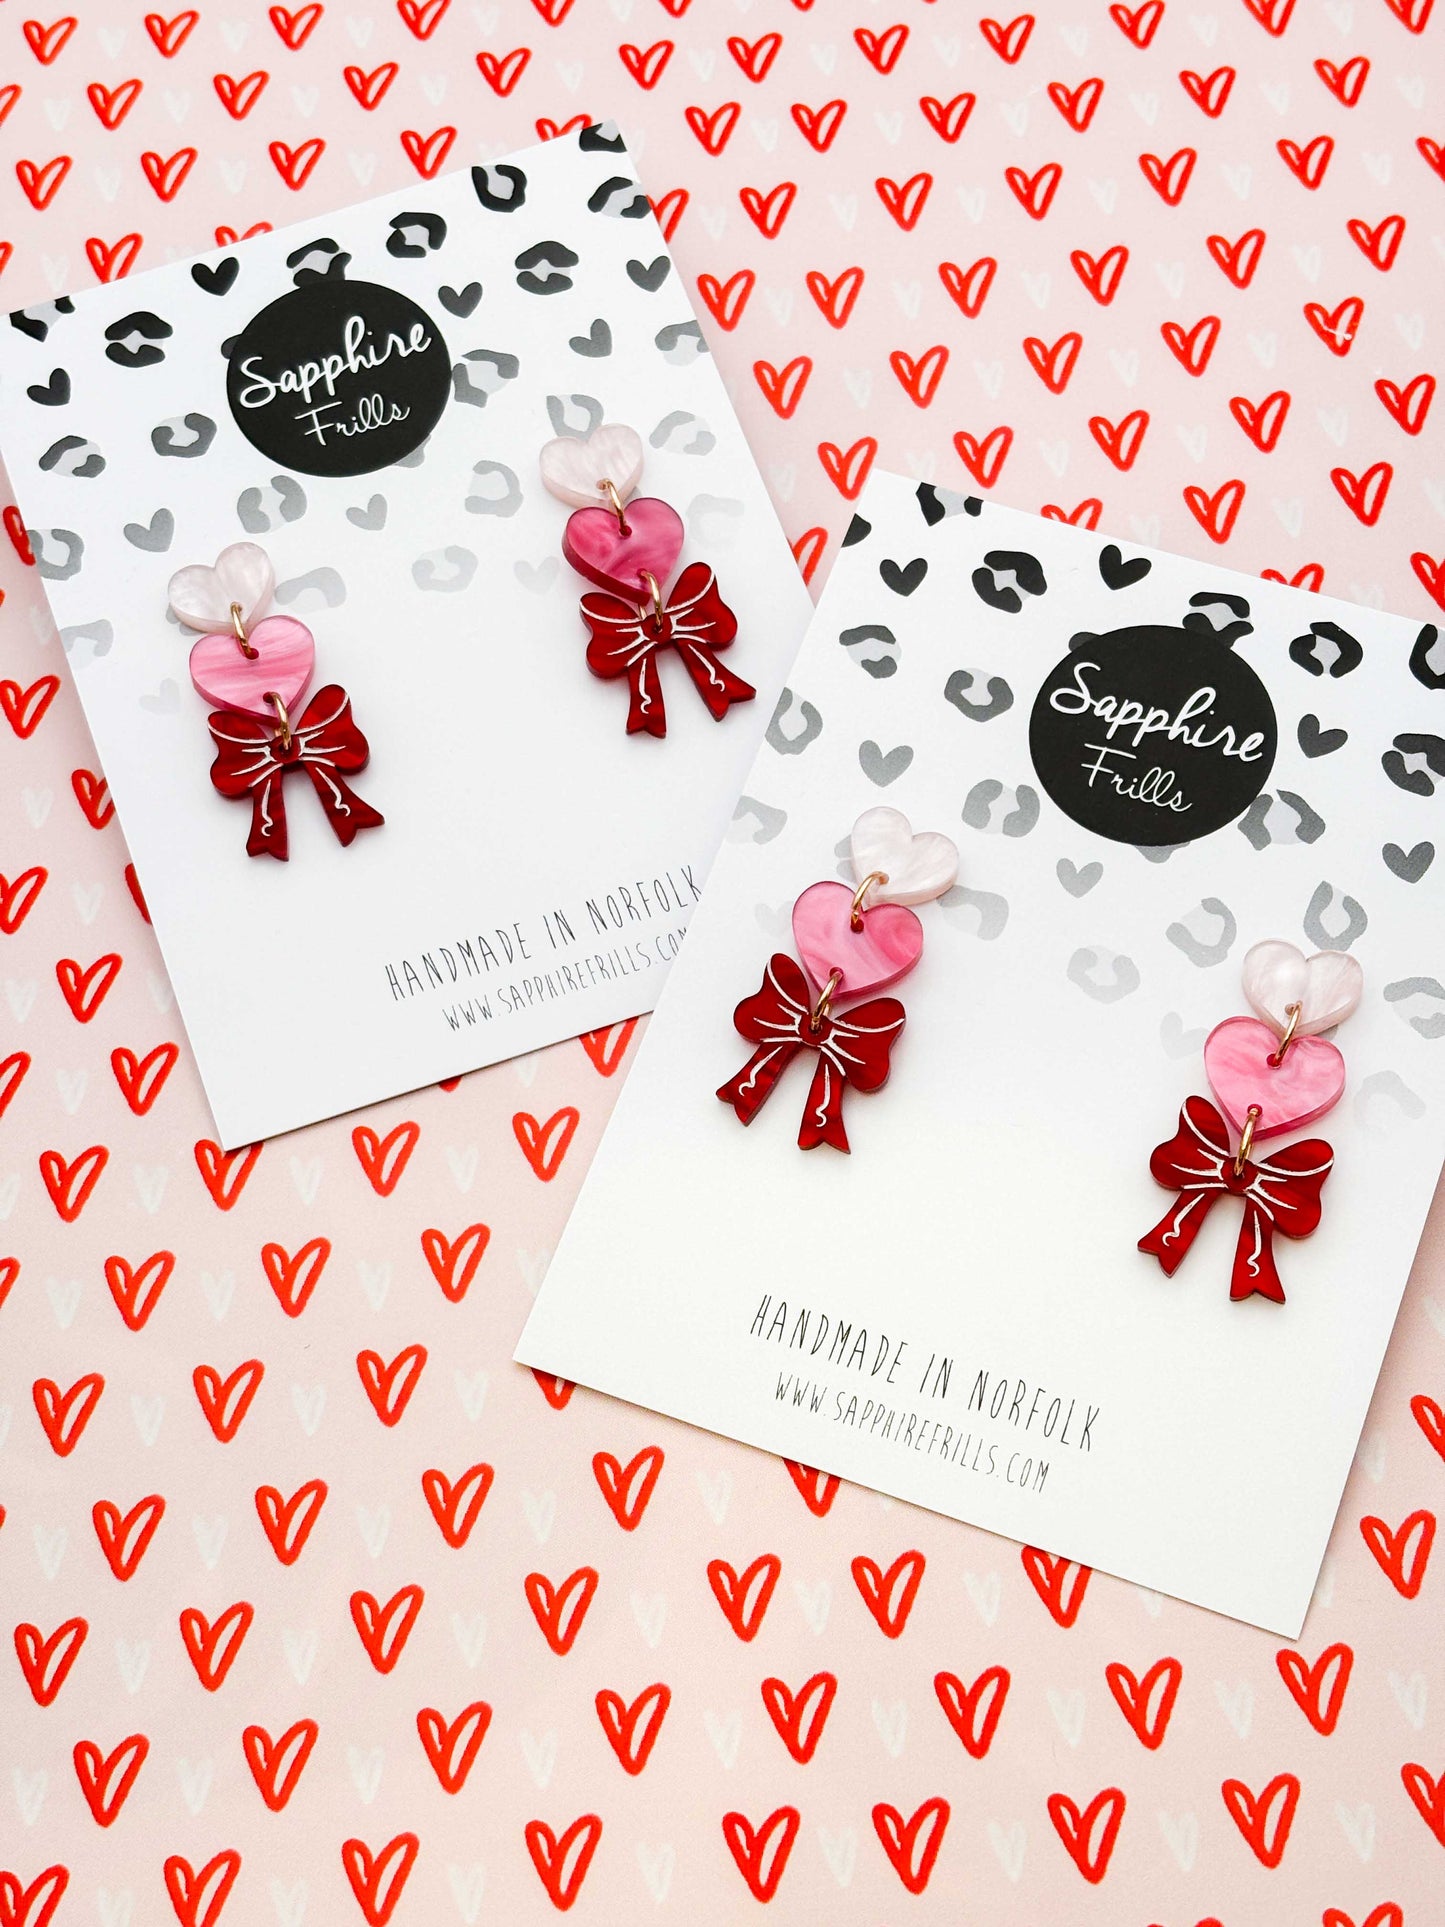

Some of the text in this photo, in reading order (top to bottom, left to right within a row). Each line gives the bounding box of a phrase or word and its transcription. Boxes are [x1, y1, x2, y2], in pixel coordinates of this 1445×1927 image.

[240, 315, 432, 409] Sapphire
[294, 393, 411, 446] Frills
[1050, 661, 1265, 762] Sapphire
[1081, 743, 1193, 812] Frills
[385, 865, 702, 1001] HANDMADE IN NORFOLK
[750, 1294, 1101, 1453] HANDMADE IN NORFOLK
[775, 1371, 1051, 1494] WWW.SAPPHIREFRILLS.COM
